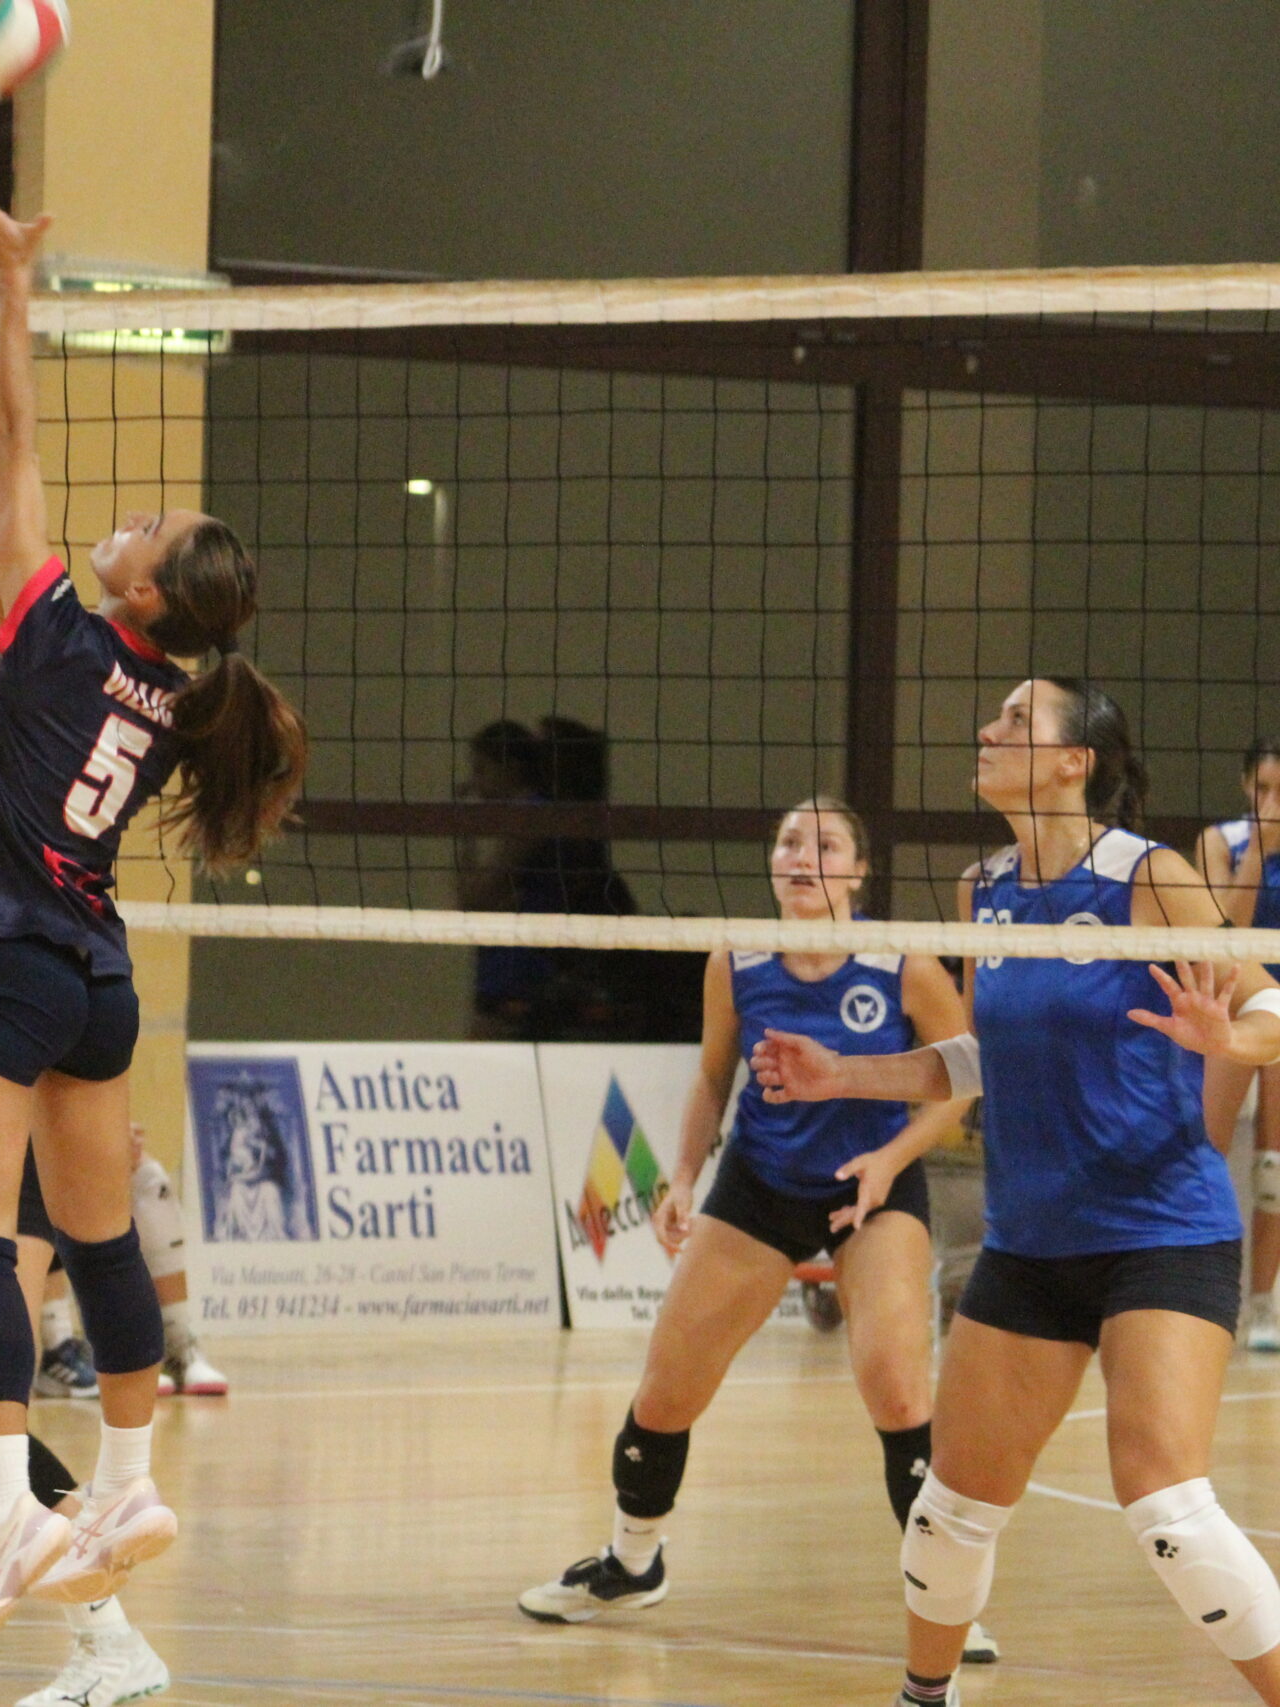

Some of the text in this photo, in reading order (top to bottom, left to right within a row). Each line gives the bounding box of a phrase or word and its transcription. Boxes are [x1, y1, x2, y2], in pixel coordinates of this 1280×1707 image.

[63, 711, 153, 840] 5
[316, 1060, 460, 1112] Antica
[321, 1121, 532, 1175] Farmacia
[327, 1185, 436, 1239] Sarti
[202, 1295, 229, 1319] Tel.
[238, 1295, 268, 1319] 051
[276, 1294, 340, 1318] 941234
[357, 1293, 549, 1321] www.farmaciasarti.net
